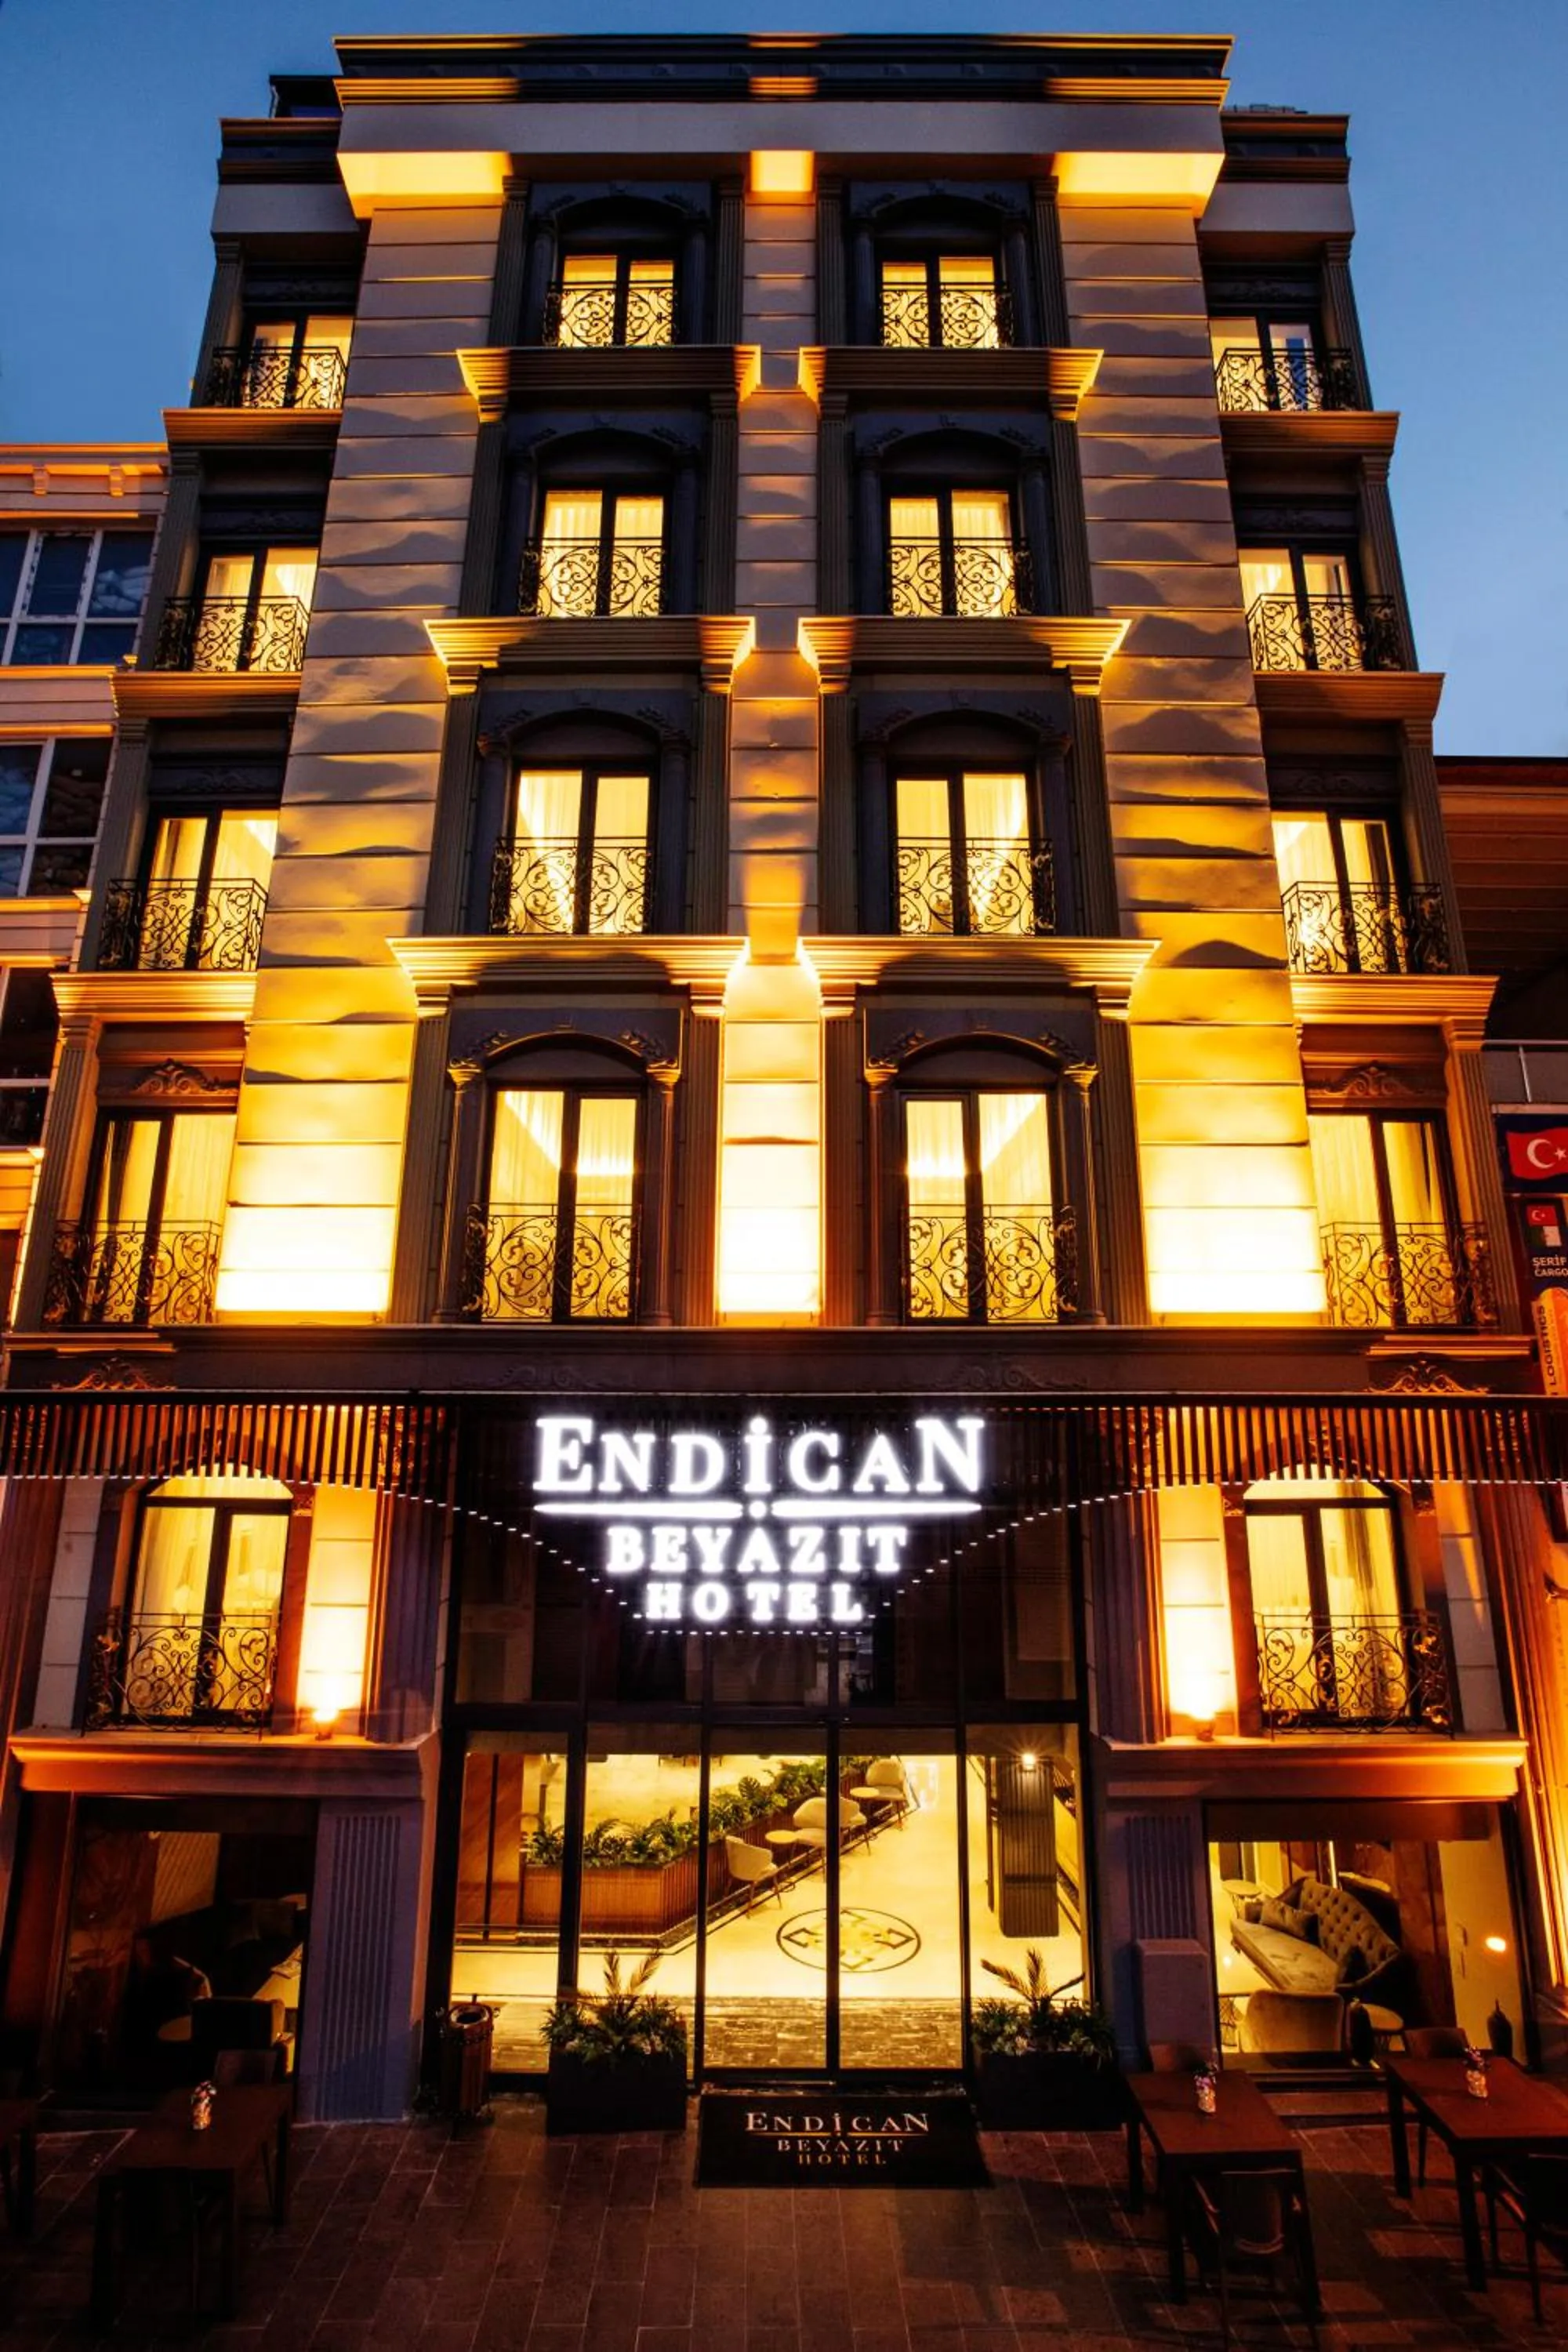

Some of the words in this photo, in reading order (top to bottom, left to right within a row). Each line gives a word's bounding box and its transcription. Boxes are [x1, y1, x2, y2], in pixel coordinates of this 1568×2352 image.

[1538, 1305, 1556, 1385] LOGISTICS
[606, 1526, 906, 1573] BEYAZIT
[646, 1582, 862, 1621] HOTEL
[778, 2140, 903, 2151] BEYAZIT
[798, 2154, 887, 2165] HOTEL
